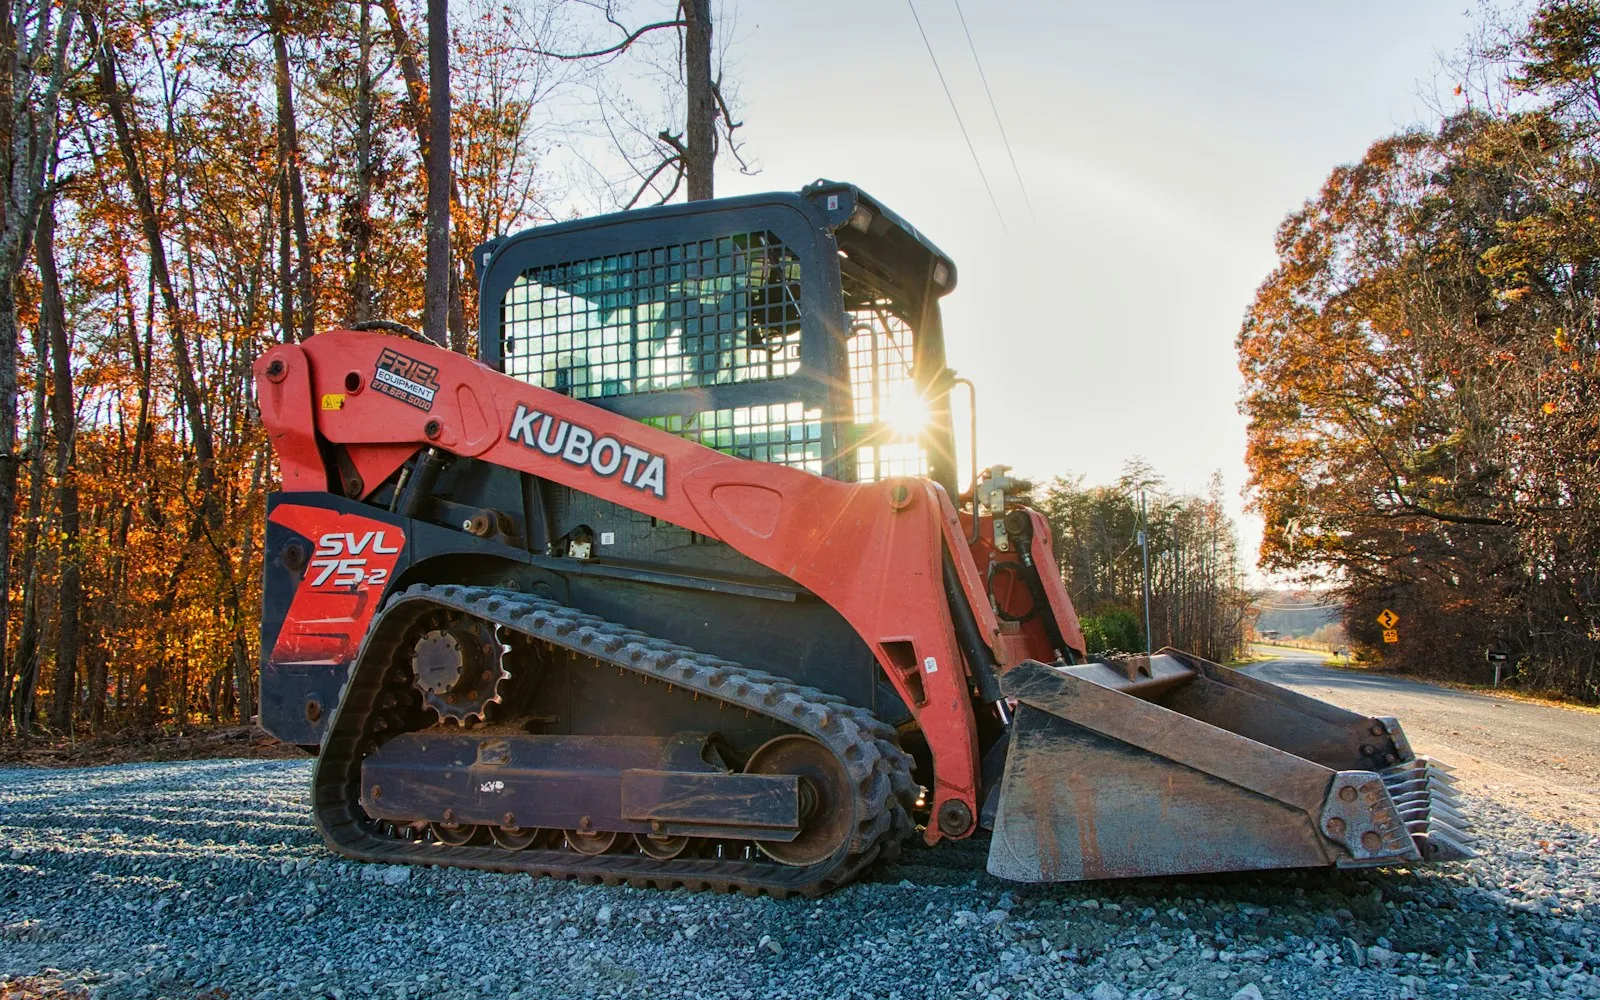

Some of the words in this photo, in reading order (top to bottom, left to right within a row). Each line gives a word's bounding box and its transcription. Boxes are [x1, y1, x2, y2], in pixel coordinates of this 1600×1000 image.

[376, 349, 439, 391] FRIEL
[378, 370, 432, 398] EQUIPMENT
[508, 404, 665, 497] KUBOTA
[315, 531, 399, 556] SVL
[311, 558, 388, 587] 75-2
